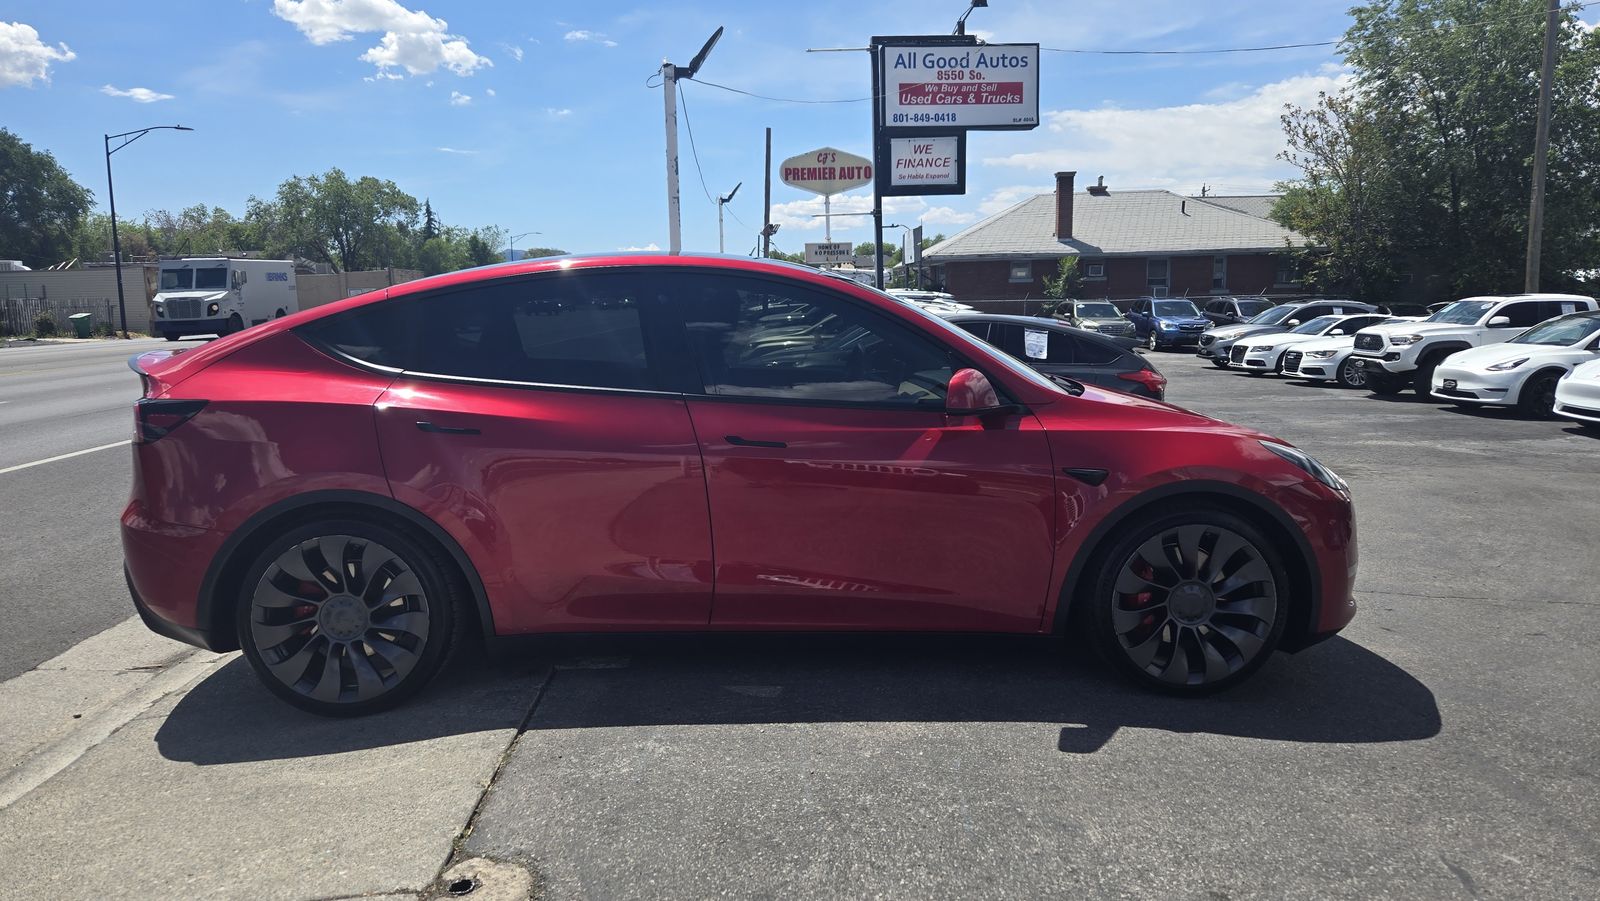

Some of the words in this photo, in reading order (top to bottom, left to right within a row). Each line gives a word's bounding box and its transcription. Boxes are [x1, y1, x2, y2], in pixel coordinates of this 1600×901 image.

[894, 52, 917, 69] All
[922, 52, 970, 69] Good
[976, 52, 1029, 68] Autos
[936, 70, 964, 81] 8550
[968, 70, 986, 81] So.
[924, 84, 939, 92] We
[941, 84, 959, 94] Buy
[961, 84, 978, 92] and
[980, 83, 998, 92] Sell
[902, 94, 932, 104] Used
[935, 94, 963, 104] Cars
[967, 93, 976, 104] &
[981, 92, 1020, 103] Trucks
[892, 113, 957, 123] 801-849-0418
[914, 144, 934, 155] WE
[896, 157, 951, 169] FINANCE
[784, 166, 836, 181] PREMIER
[838, 166, 872, 180] AUTO
